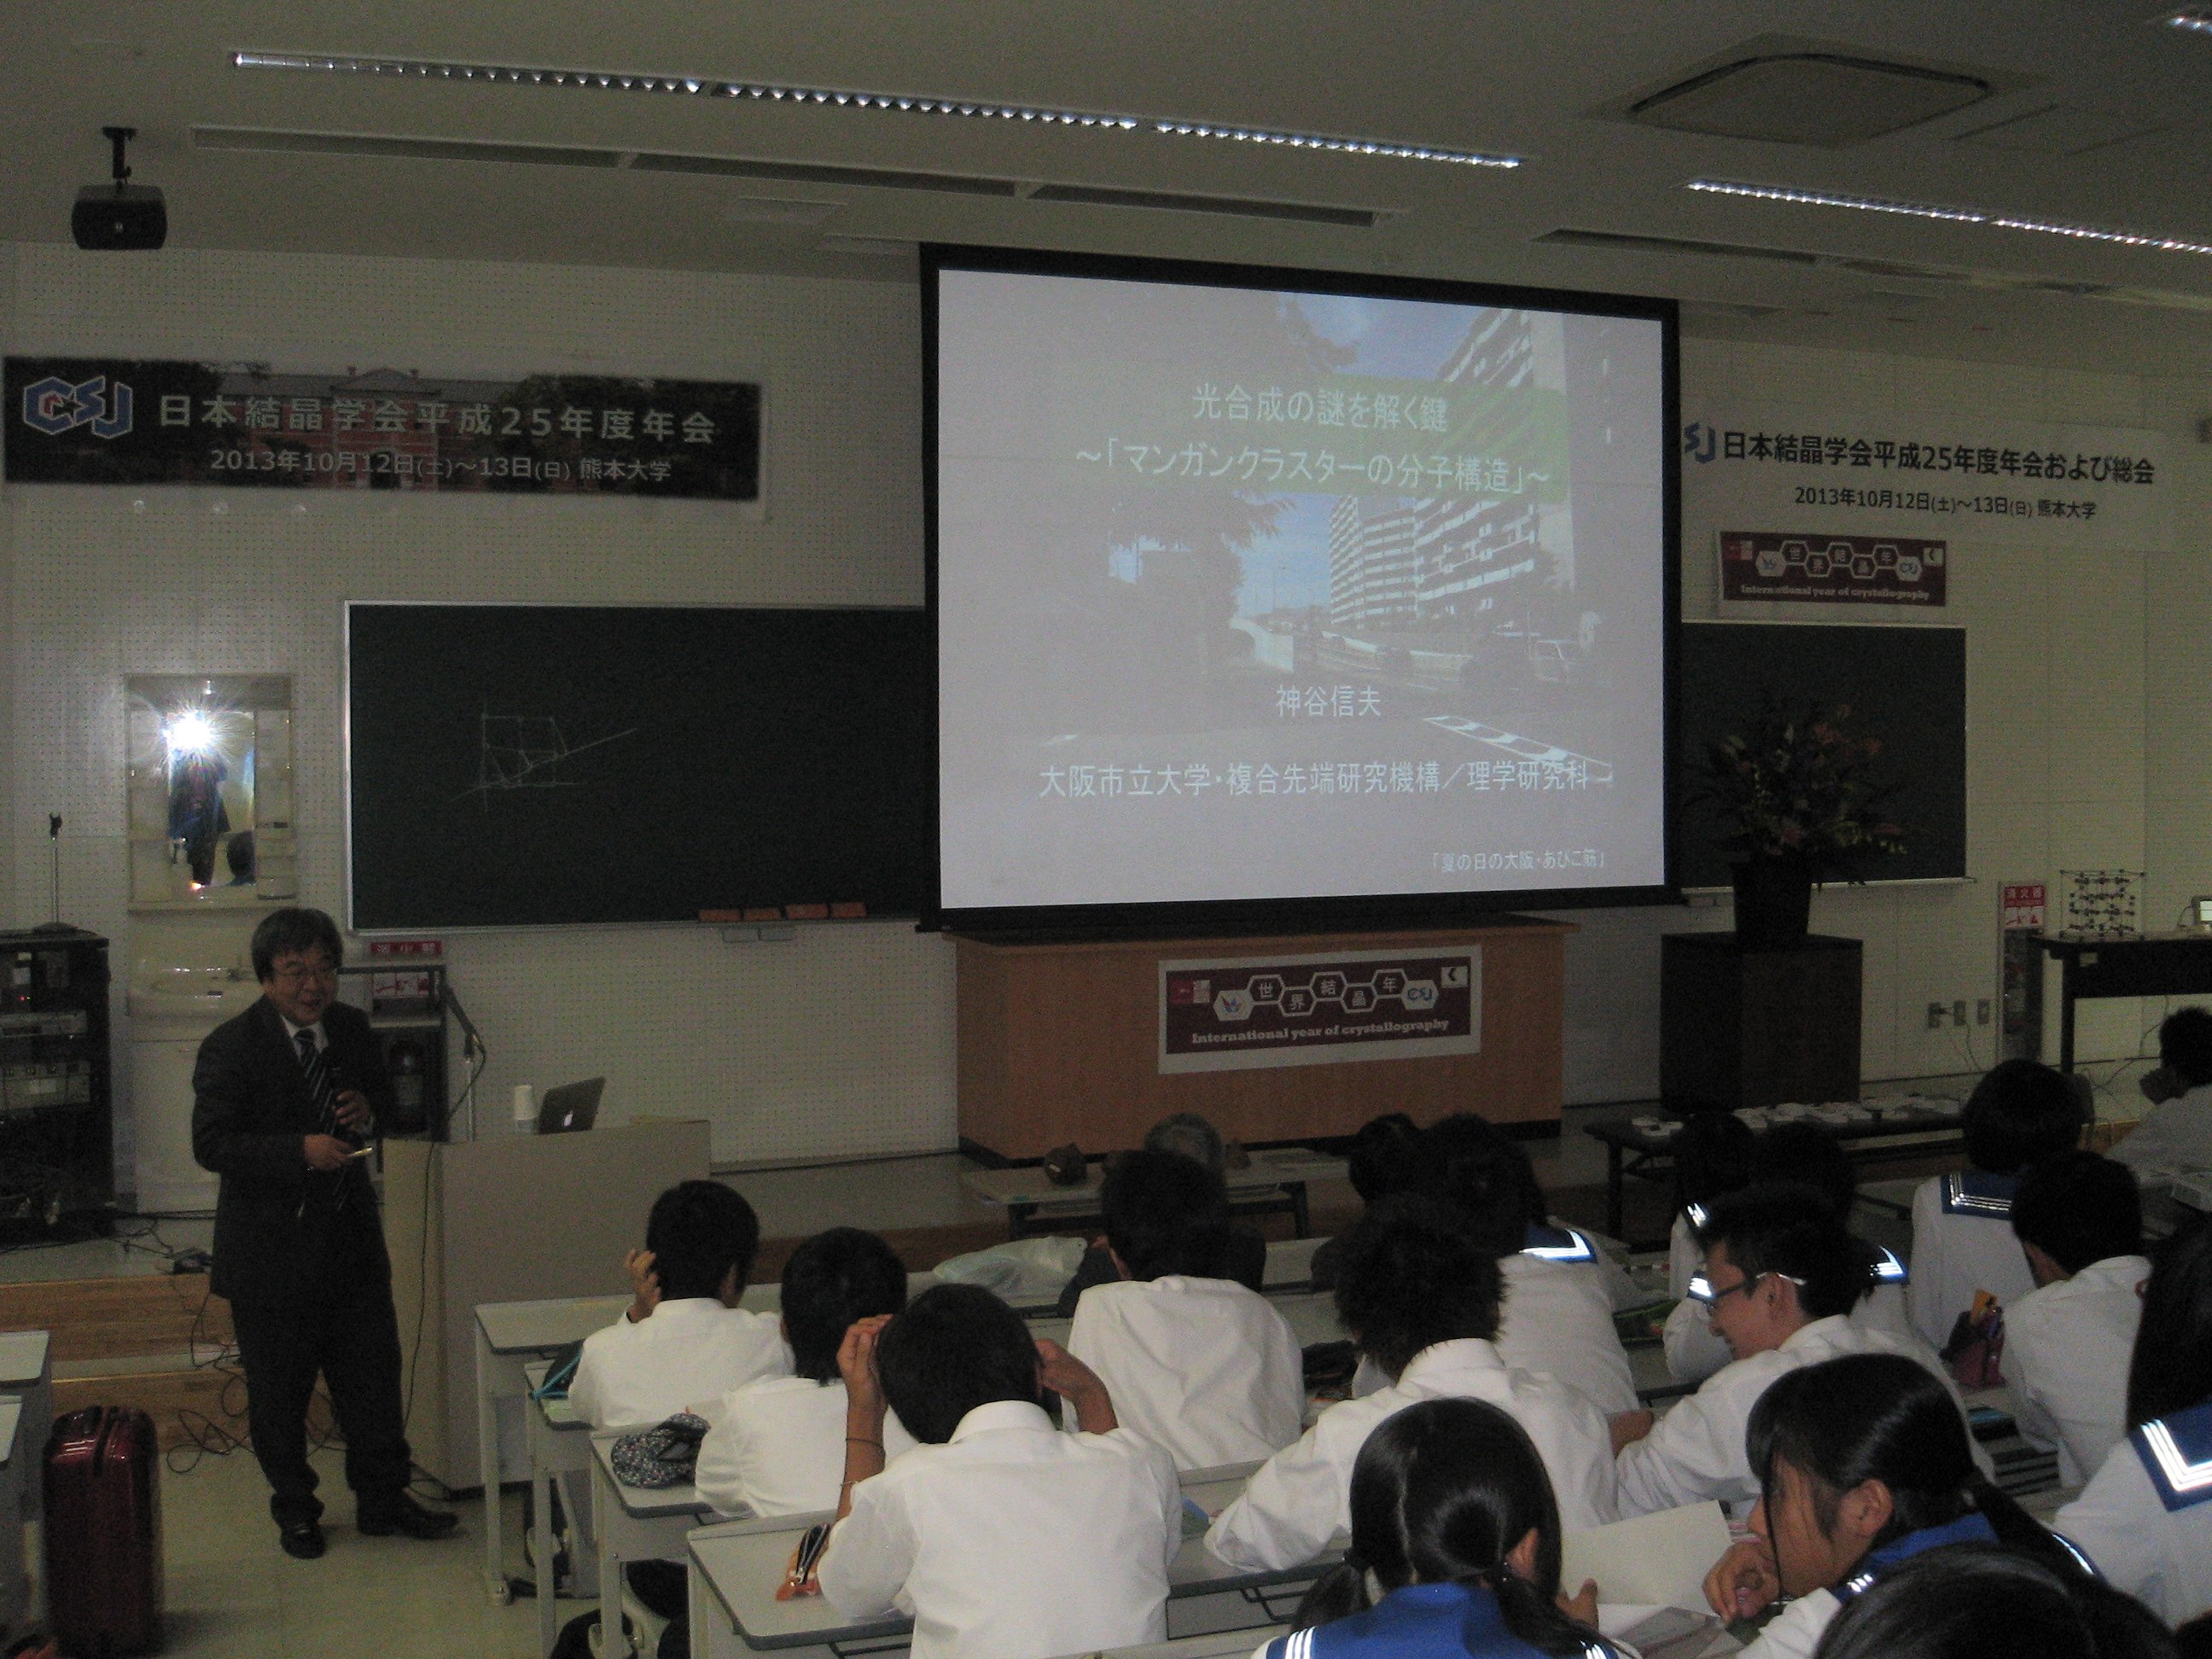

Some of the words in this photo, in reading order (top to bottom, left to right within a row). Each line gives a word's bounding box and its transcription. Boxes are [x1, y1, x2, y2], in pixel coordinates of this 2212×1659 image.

[23, 375, 133, 439] CSJ
[160, 394, 716, 445] 日本結晶学会平成25年度年会
[1191, 382, 1449, 433] 光合成の謎を解く鍵
[1684, 422, 1717, 465] SJ
[1723, 431, 2155, 485] 日本結晶学会平成25年度年会および総会
[579, 457, 672, 483] 熊本大学
[2037, 498, 2098, 520] 熊本大学
[1276, 684, 1382, 719] 神谷信夫
[1192, 1028, 1289, 1045] International
[1292, 1028, 1323, 1040] year
[1324, 1025, 1338, 1037] of
[1342, 1019, 1450, 1036] crystallography
